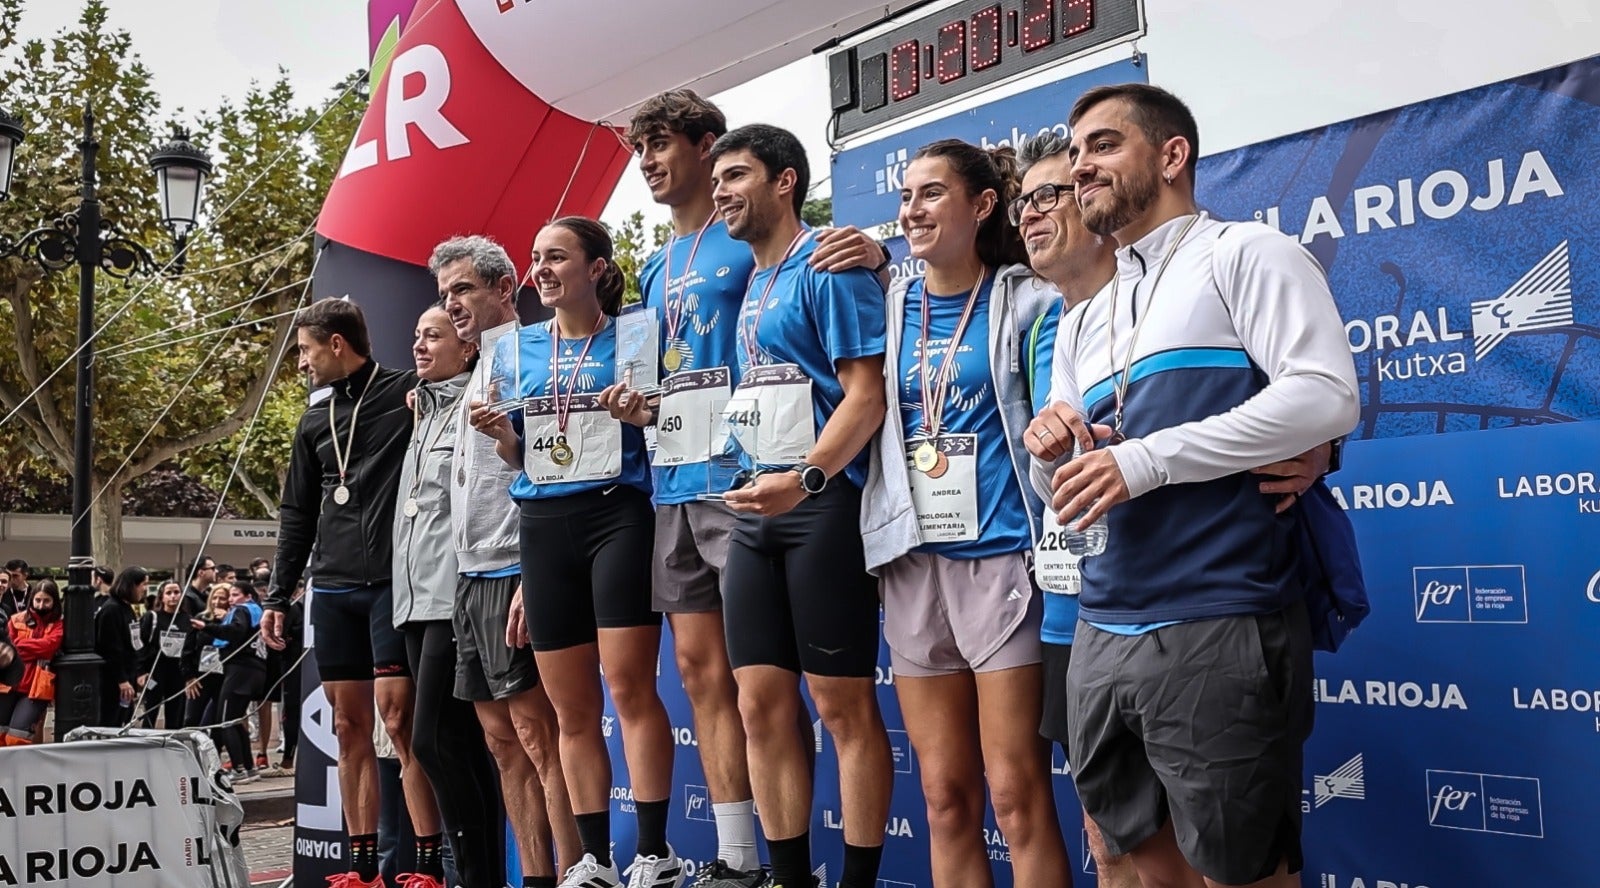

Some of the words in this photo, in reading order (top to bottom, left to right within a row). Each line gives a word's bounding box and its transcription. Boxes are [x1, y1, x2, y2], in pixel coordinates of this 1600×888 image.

[1354, 150, 1564, 234] RIOJA
[1377, 352, 1466, 382] kutxa
[661, 415, 682, 433] 450
[728, 410, 761, 427] 448
[931, 489, 962, 497] ANDREA
[1353, 480, 1454, 510] RIOJA
[1498, 472, 1600, 498] LABOR
[1417, 580, 1462, 622] fer
[1319, 679, 1361, 705] LA
[1366, 681, 1468, 710] RIOJA
[25, 779, 157, 816] RIOJA
[180, 776, 188, 805] DIARIO
[1430, 784, 1476, 825] fer
[26, 842, 160, 884] RIOJA
[297, 838, 341, 860] DIARIO
